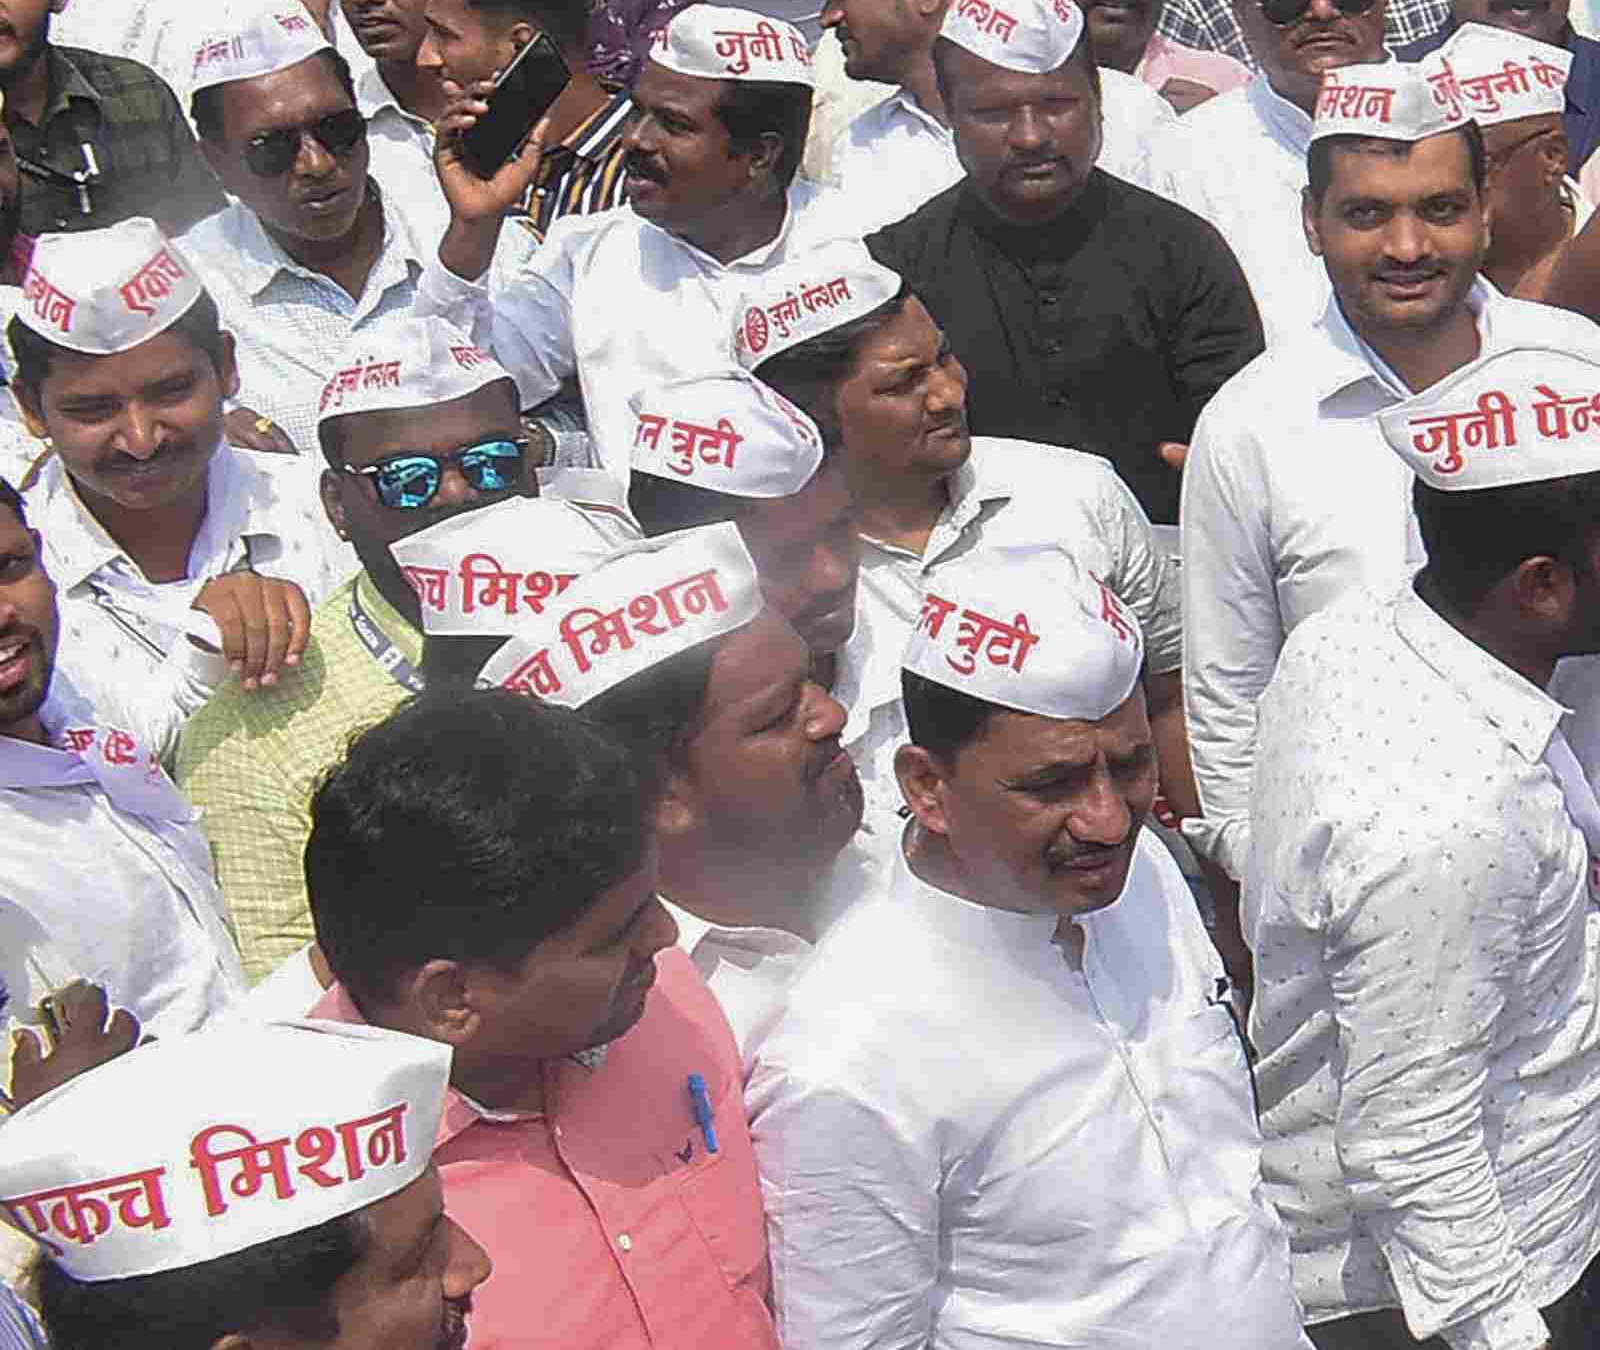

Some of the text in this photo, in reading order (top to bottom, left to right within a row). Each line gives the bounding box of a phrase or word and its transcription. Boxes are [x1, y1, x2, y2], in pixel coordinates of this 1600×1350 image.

[711, 21, 783, 76] जुनी
[1461, 62, 1528, 118] जुनी
[671, 409, 744, 477] त्रुटी
[1408, 393, 1519, 474] जुनी
[459, 552, 576, 616] मिश
[557, 568, 730, 674] मिशन
[956, 605, 1039, 674] त्रुटी
[2, 1099, 410, 1258] एकच मिशन
